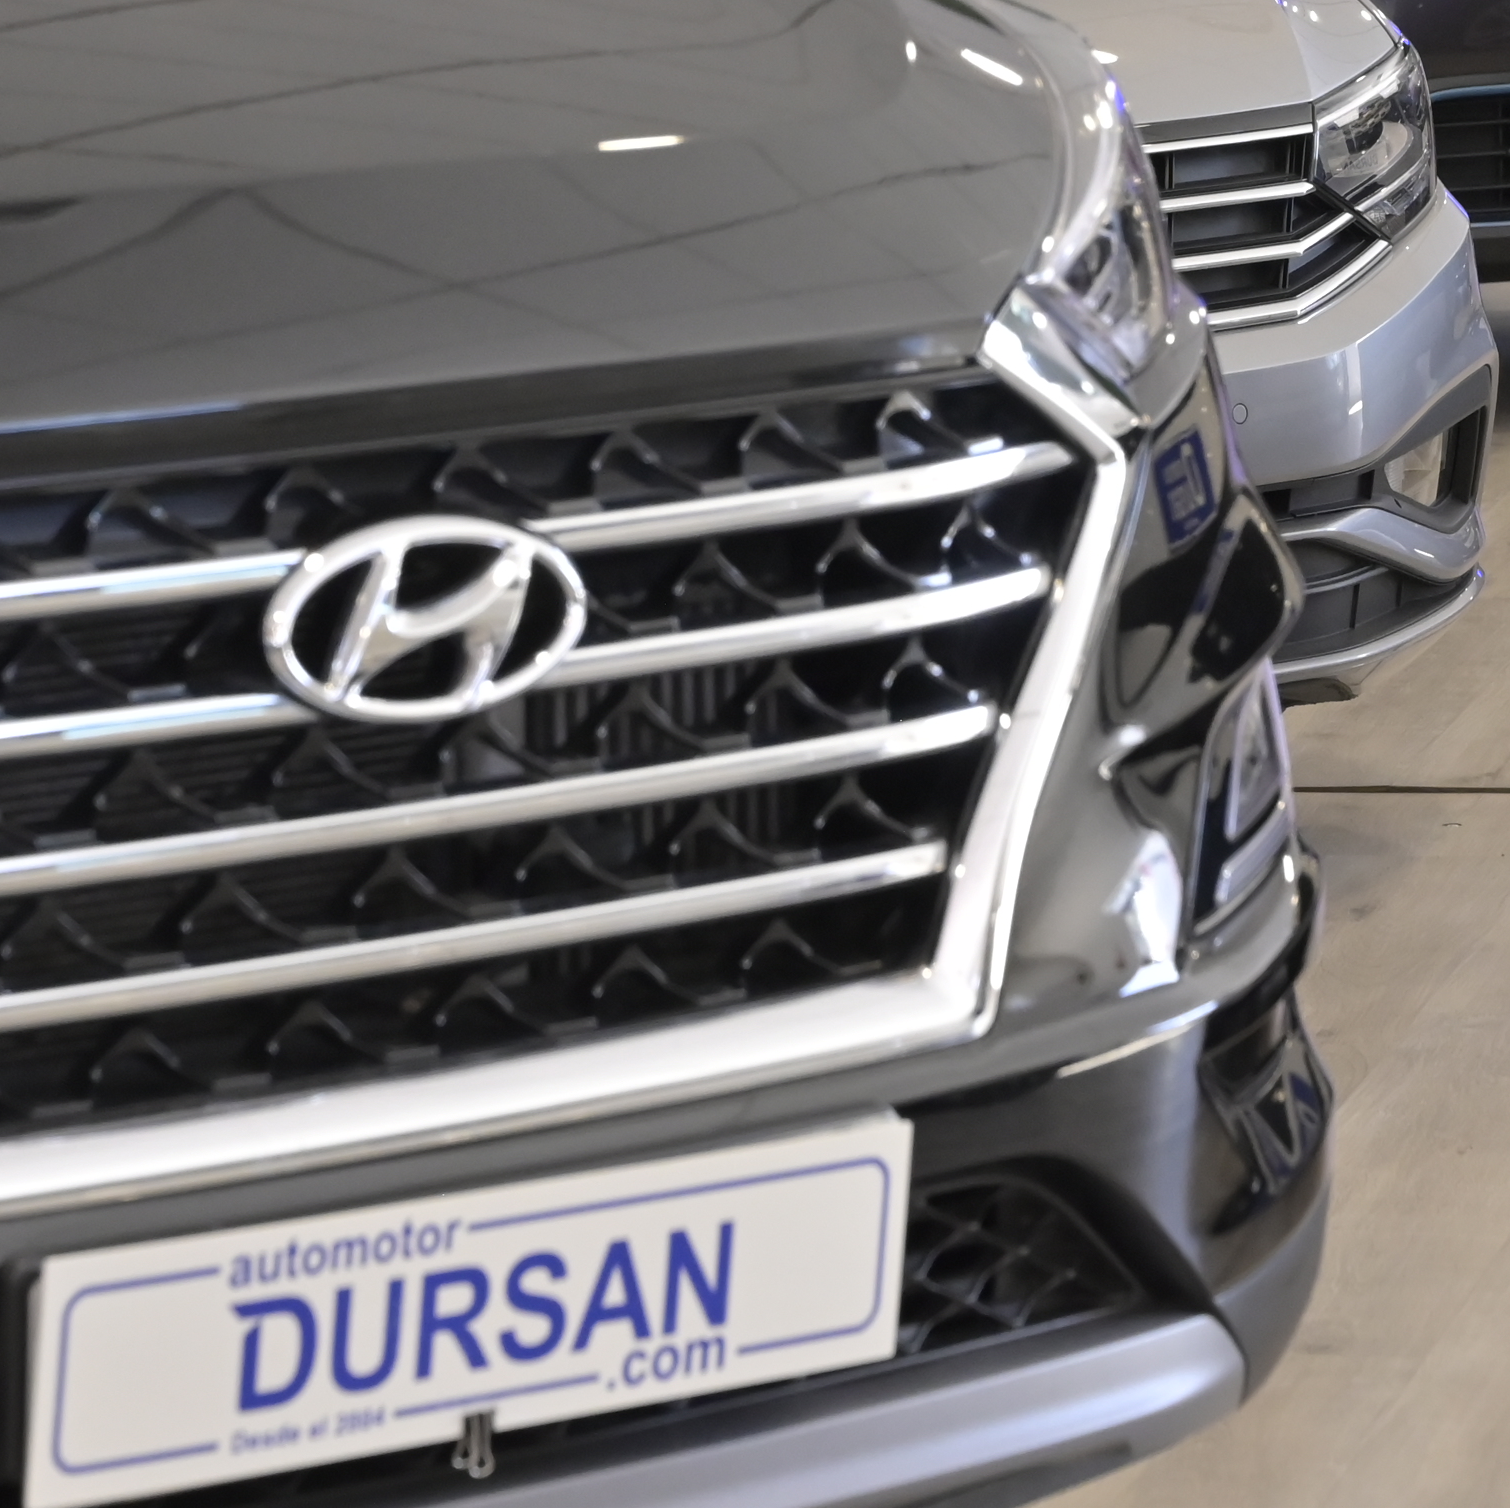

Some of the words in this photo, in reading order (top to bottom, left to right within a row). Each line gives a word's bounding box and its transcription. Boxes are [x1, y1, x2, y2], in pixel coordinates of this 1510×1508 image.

[229, 1219, 463, 1289] automotor
[231, 1220, 736, 1414] DURSAN
[606, 1334, 728, 1394] .com
